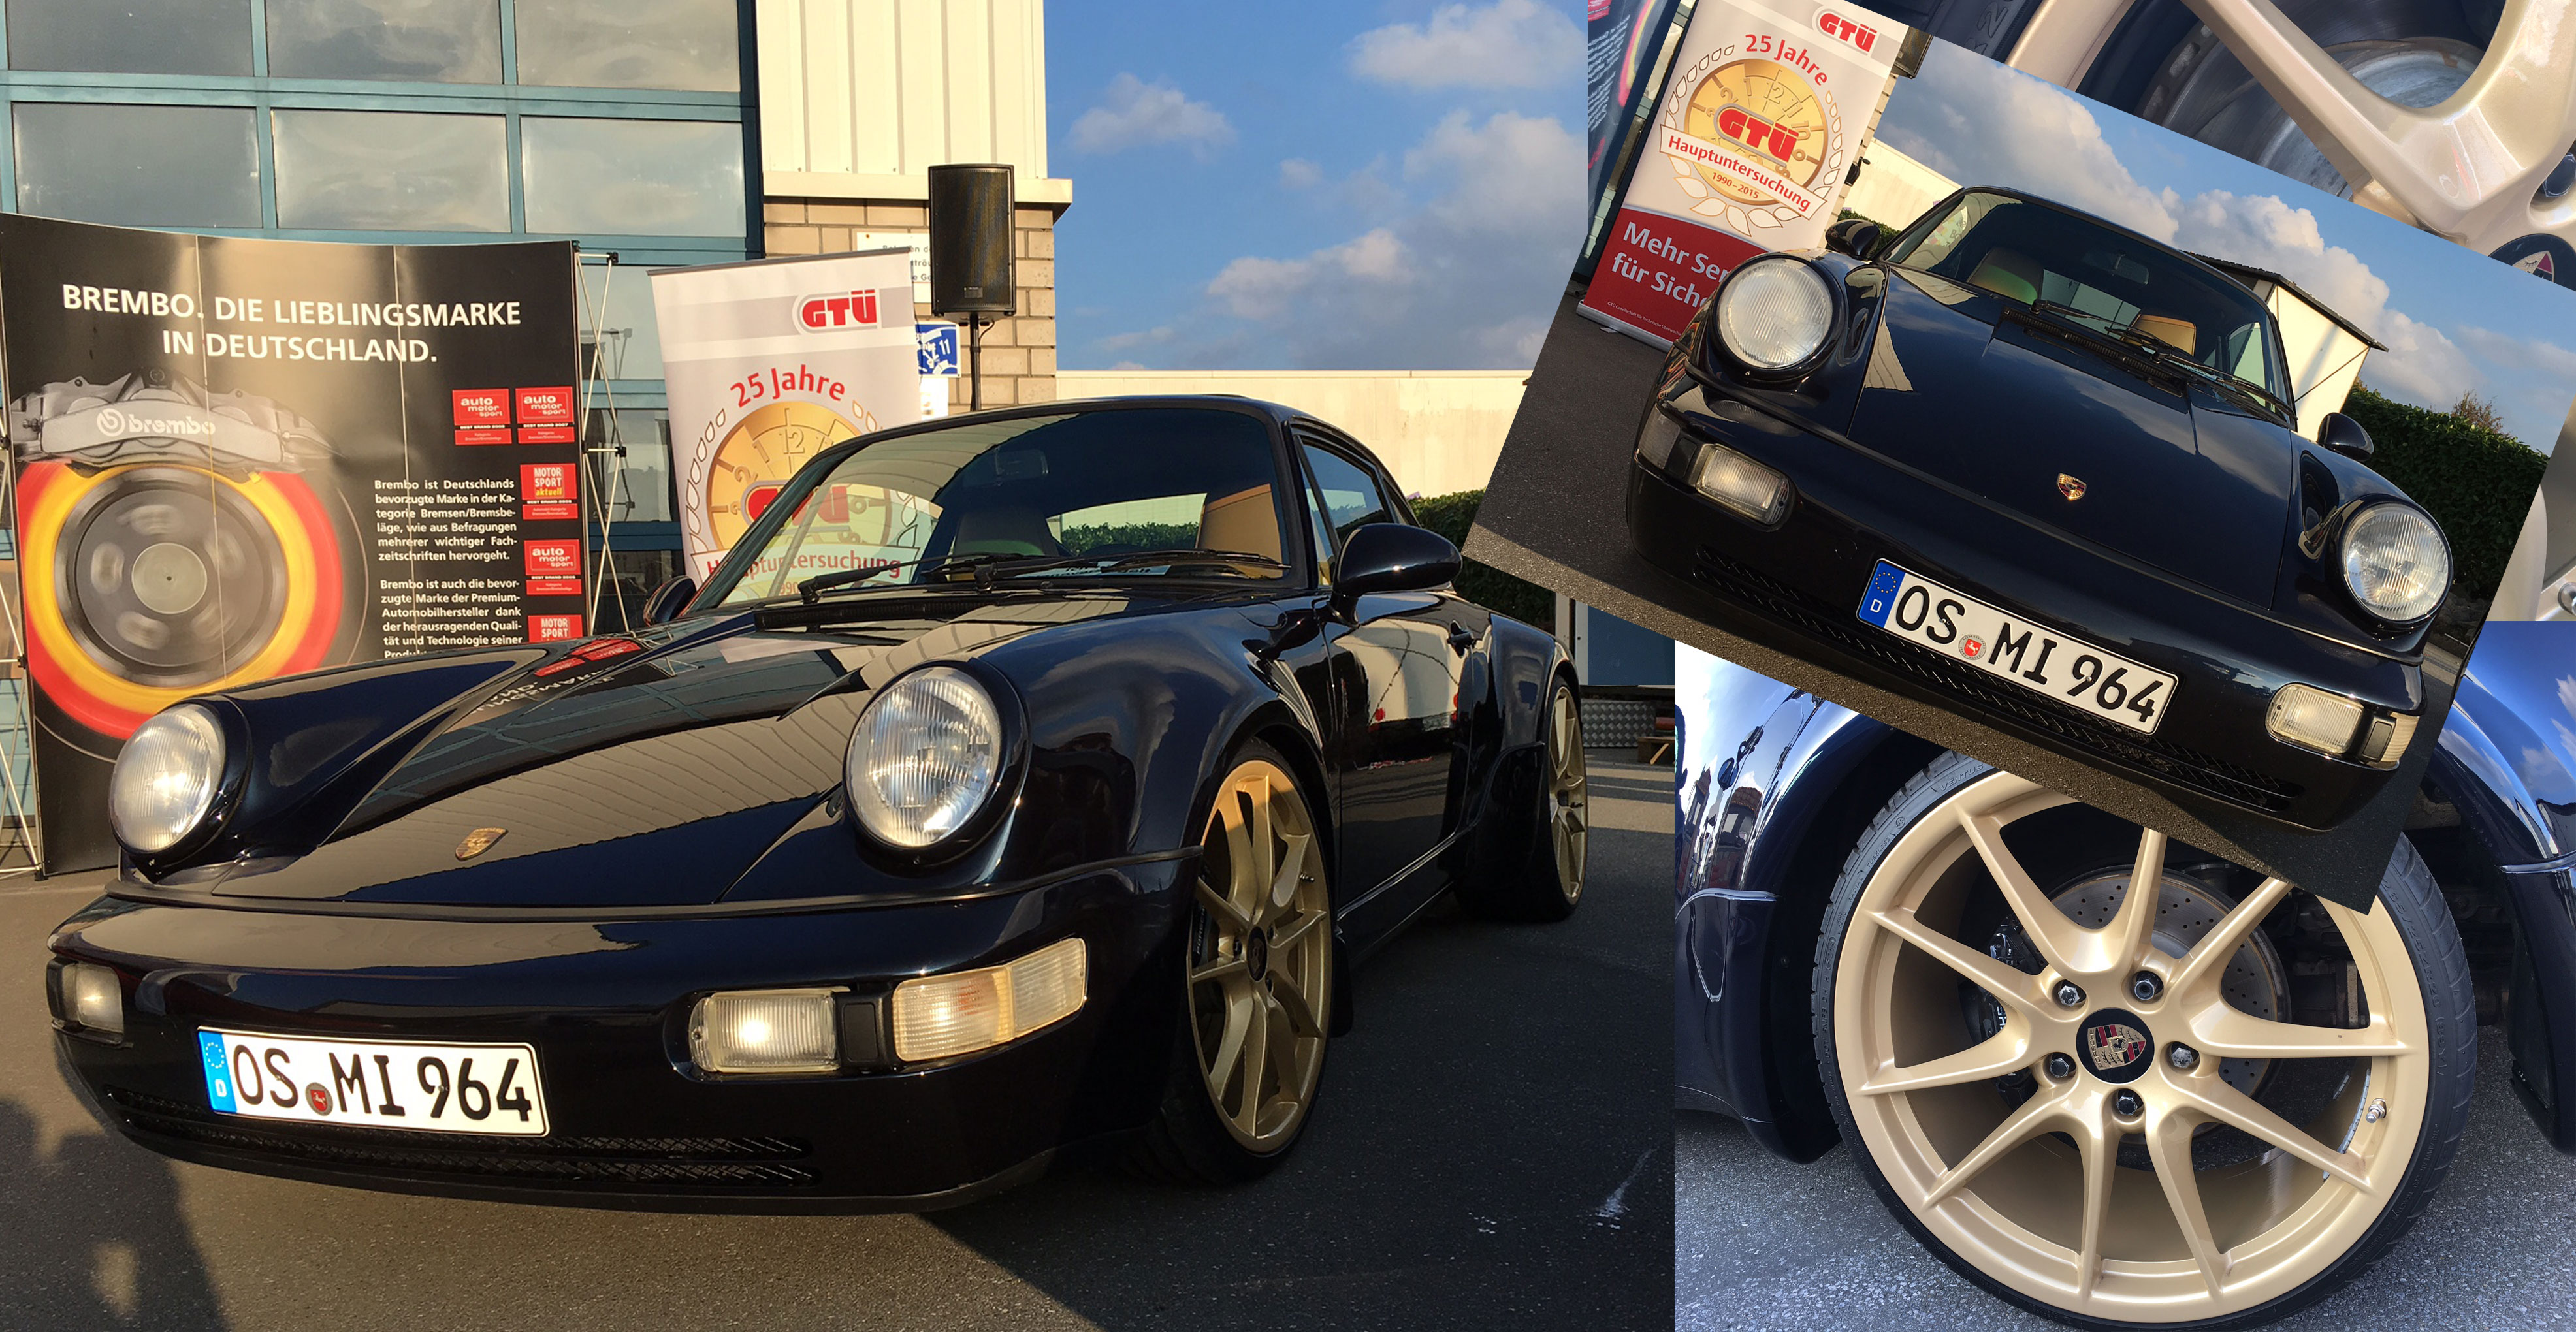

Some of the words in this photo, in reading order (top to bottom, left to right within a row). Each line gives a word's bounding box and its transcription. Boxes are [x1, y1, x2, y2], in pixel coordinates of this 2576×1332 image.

[1820, 13, 1877, 52] GTÜ
[1745, 34, 1771, 52] 25
[1774, 40, 1827, 86] Jahre
[1719, 106, 1799, 163] GTÜ
[1668, 135, 1811, 212] Hauptuntersuchung
[1623, 221, 1689, 265] Mehr
[1611, 252, 1649, 283] für
[63, 283, 204, 319] BREMBO.
[214, 296, 263, 322] DIE
[274, 300, 521, 326] LIEBLINGSMARKE
[802, 289, 877, 328] GTÜ
[163, 330, 194, 355] IN
[205, 333, 438, 362] DEUTSCHLAND.
[730, 372, 765, 408] 25
[771, 364, 845, 401] Jahre
[460, 397, 493, 406] auto
[524, 395, 556, 404] auto
[128, 413, 216, 436] brembo
[534, 467, 562, 477] MOTOR
[374, 479, 419, 490] Brembo
[425, 479, 438, 489] ist
[443, 479, 515, 490] Deutschlands
[535, 477, 562, 487] SPORT
[536, 487, 562, 496] aktuell
[376, 494, 434, 506] bevorzugte
[436, 494, 468, 504] Marke
[470, 494, 479, 503] in
[481, 493, 498, 503] der
[499, 493, 515, 503] Ka-
[376, 508, 416, 520] tegorie
[421, 507, 516, 518] Bremsen/Bremsbe-
[377, 522, 403, 534] läge,
[406, 523, 427, 532] wie
[451, 522, 517, 533] Befragungen
[378, 537, 428, 547] mehrerer
[434, 536, 485, 548] wichtiger
[491, 535, 517, 546] Fach-
[378, 550, 446, 562] zeitschriften
[449, 550, 510, 562] hervorgeht.
[532, 548, 564, 556] auto
[380, 580, 423, 590] Brembo
[426, 579, 439, 589] ist
[441, 579, 466, 589] auch
[468, 579, 485, 588] die
[487, 579, 520, 588] bevor-
[381, 595, 412, 605] zugte
[416, 593, 449, 603] Marke
[451, 593, 469, 603] der
[472, 592, 521, 603] Premium-
[382, 607, 489, 618] Automobilhersteller
[495, 607, 521, 617] dank
[383, 622, 401, 631] der
[403, 621, 489, 633] herausragenden
[491, 621, 522, 632] Quali-
[541, 618, 568, 627] MOTOR
[541, 628, 569, 638] SPORT
[383, 637, 400, 646] tät
[402, 636, 424, 645] und
[427, 635, 489, 647] Technologie
[491, 635, 523, 644] seiner
[1869, 598, 1882, 614] D
[1895, 585, 1966, 644] OS
[1988, 622, 2058, 686] MI
[2067, 654, 2164, 723] 964
[1939, 763, 1984, 791] VENTUS
[1848, 877, 1864, 902] RADIAL
[1867, 836, 1891, 868] TUBELESS
[215, 1078, 227, 1098] D
[233, 1044, 298, 1108] OS
[329, 1052, 406, 1117] MI
[417, 1056, 532, 1122] 964
